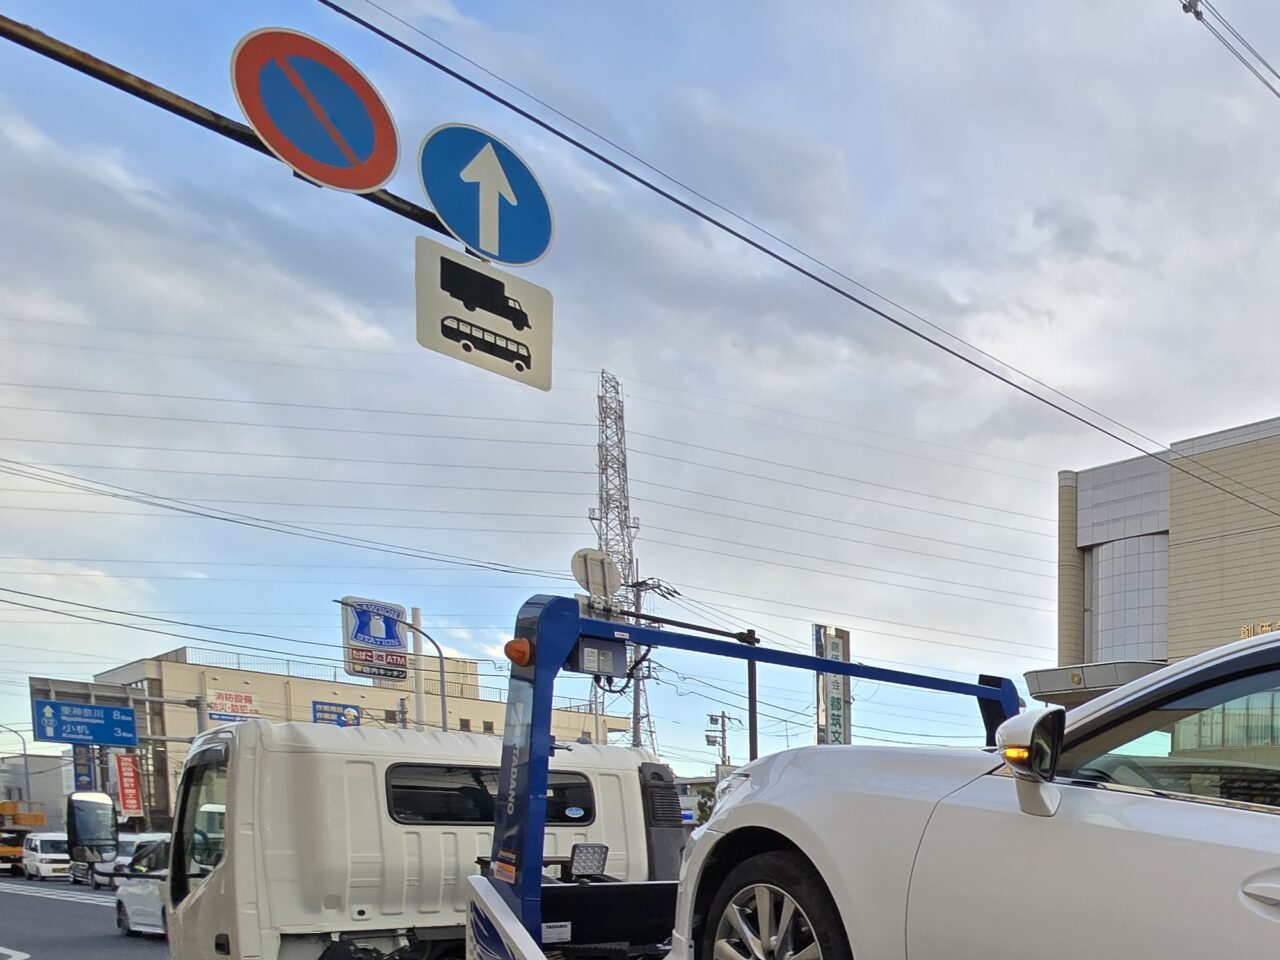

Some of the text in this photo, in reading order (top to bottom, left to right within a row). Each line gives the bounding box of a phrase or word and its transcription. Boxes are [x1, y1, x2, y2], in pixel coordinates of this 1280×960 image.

[356, 633, 400, 646] STATION
[386, 655, 406, 666] ATM
[62, 724, 90, 734] 小机
[507, 746, 520, 815] TADANO
